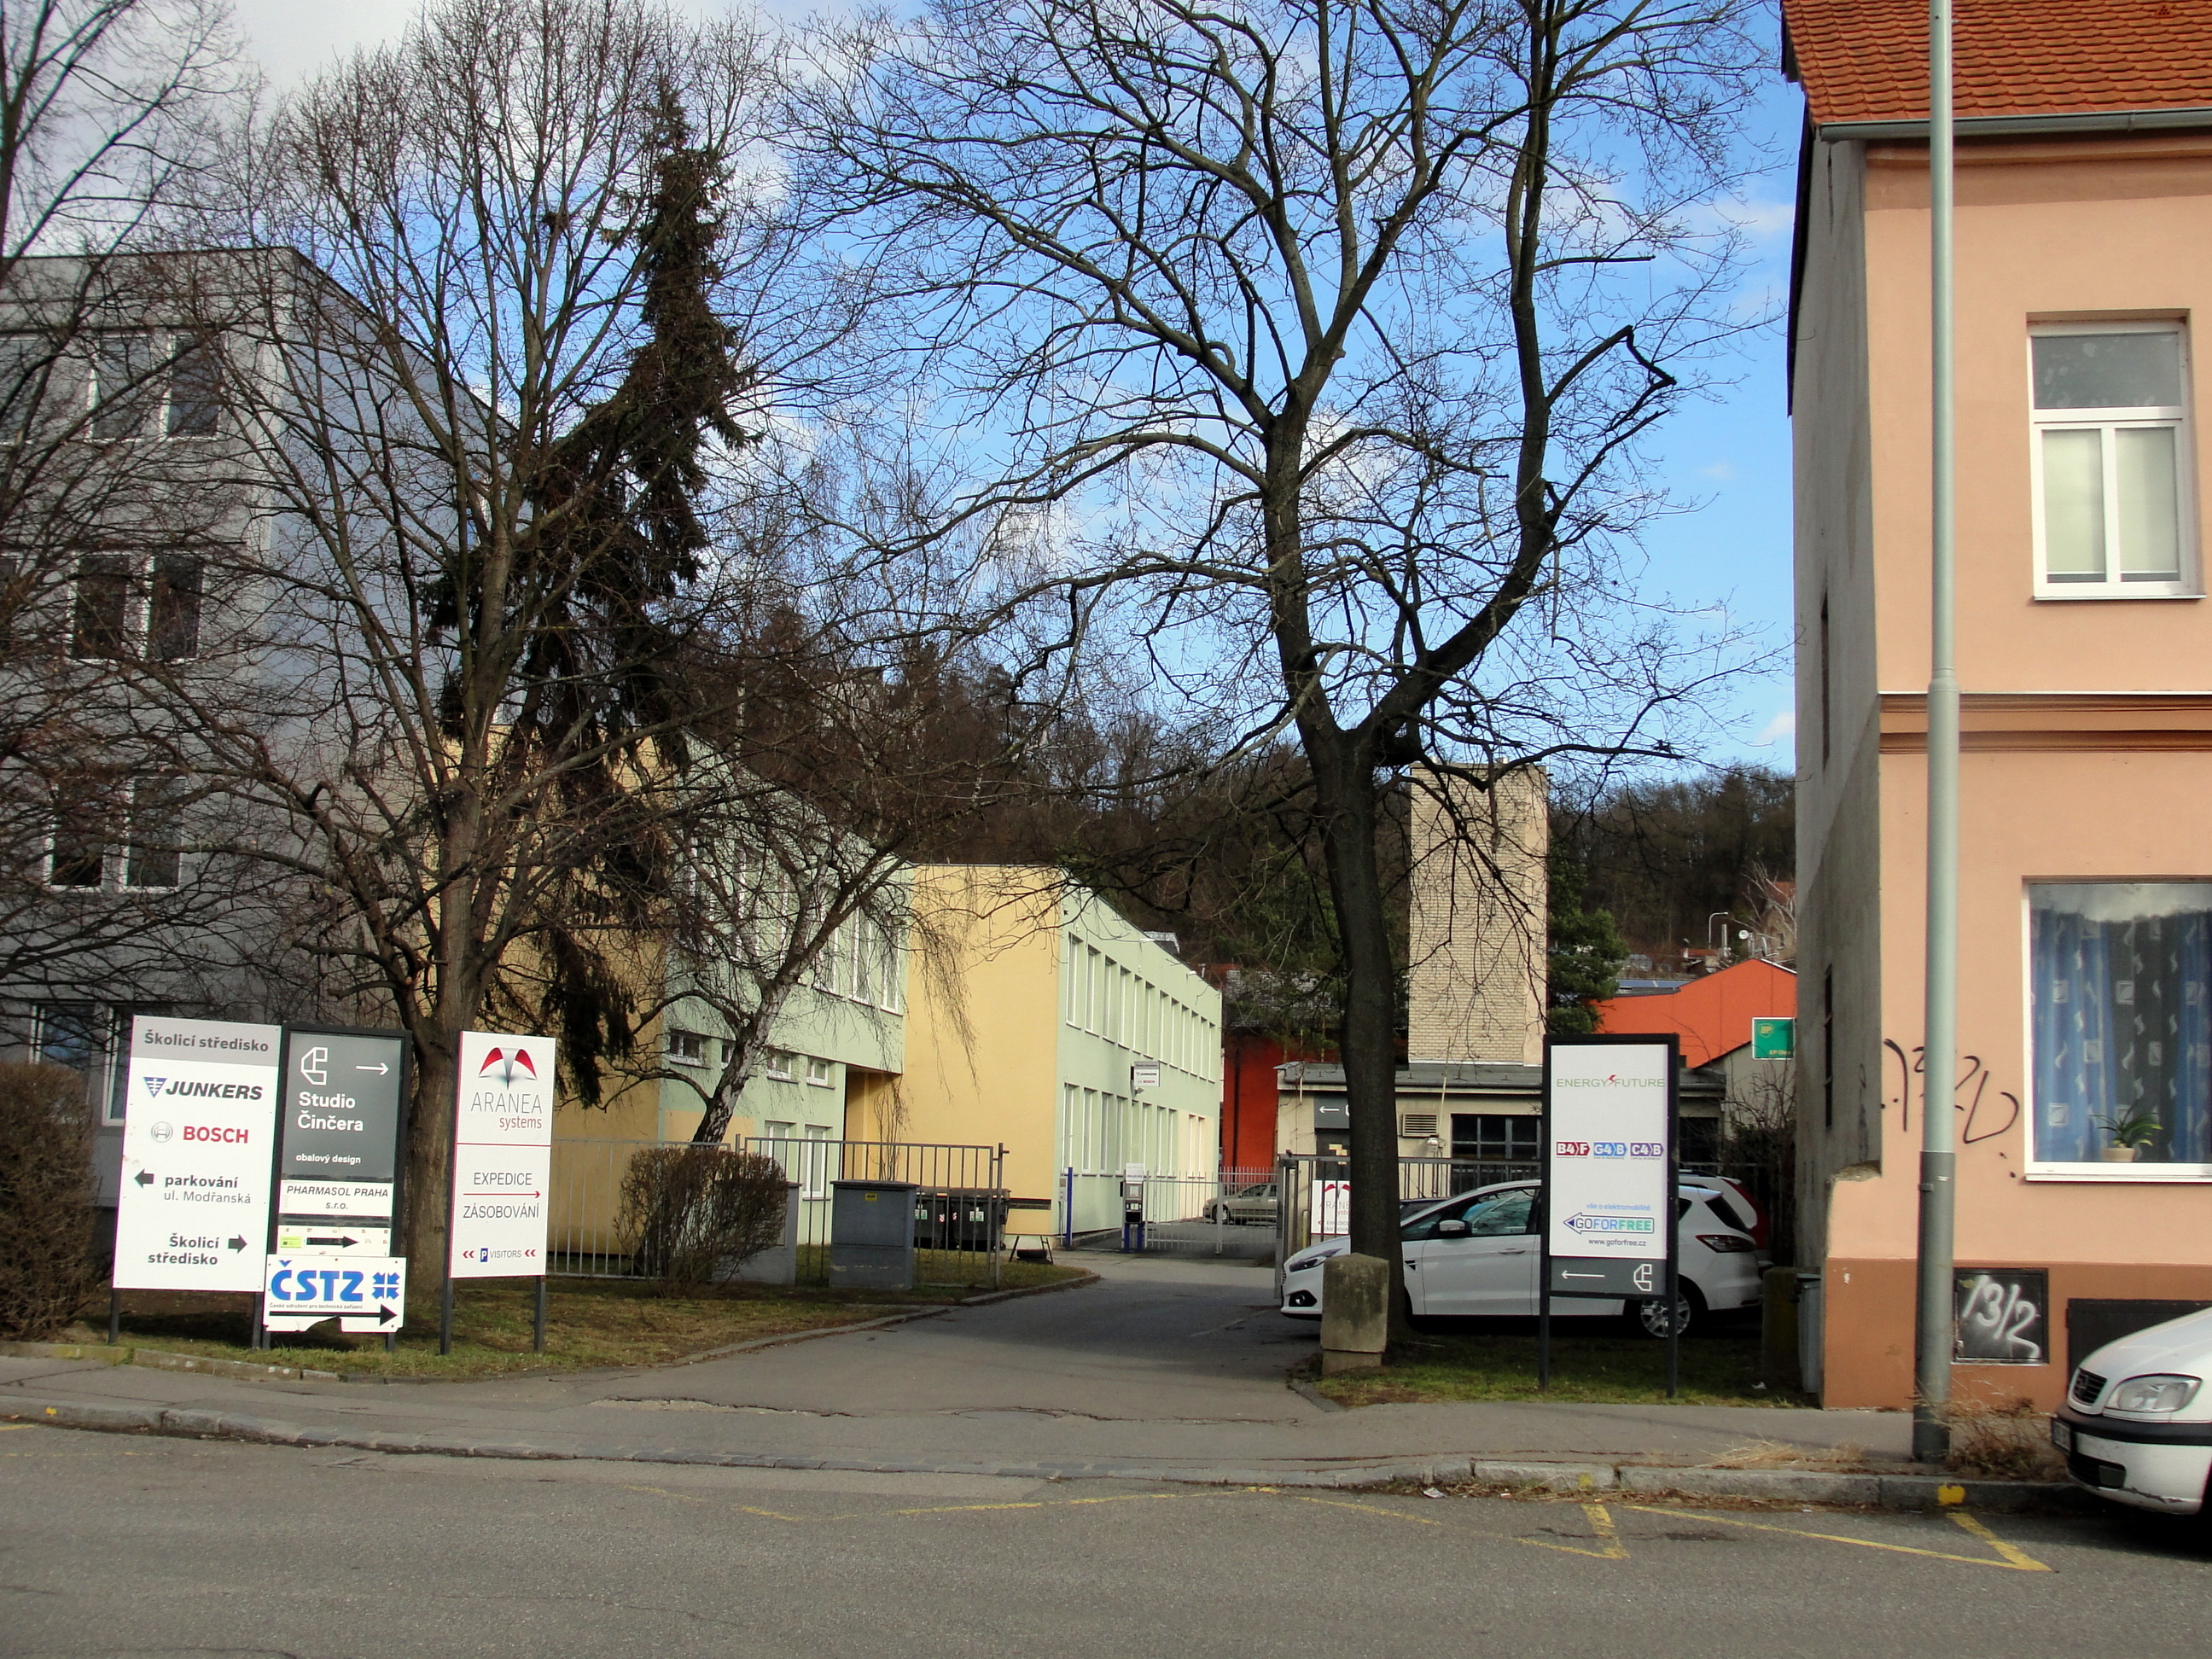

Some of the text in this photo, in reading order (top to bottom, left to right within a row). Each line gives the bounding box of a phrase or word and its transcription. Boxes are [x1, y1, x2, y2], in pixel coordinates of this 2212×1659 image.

[144, 1029, 269, 1052] Školicí středisko
[166, 1081, 263, 1100] JUNKERS
[1557, 1078, 1665, 1087] ENERGY FUTURE
[299, 1091, 356, 1109] Studio
[470, 1091, 543, 1114] ARANEA
[297, 1110, 364, 1132] Činčera
[499, 1115, 542, 1131] systems
[183, 1126, 249, 1144] BOSCH
[295, 1153, 361, 1165] obalový design
[165, 1175, 239, 1188] parkování
[474, 1173, 533, 1185] EXPEDICE
[164, 1190, 251, 1204] ul. Modřanská
[287, 1185, 388, 1197] PHARMASOL PRAHA
[463, 1202, 539, 1219] ZÁSOBOVÁNÍ
[1575, 1218, 1652, 1231] GOFORFREE
[169, 1232, 219, 1249] Školicí
[148, 1252, 218, 1265] středisko
[490, 1250, 521, 1259] VISITORS
[271, 1260, 364, 1301] ČSTZ
